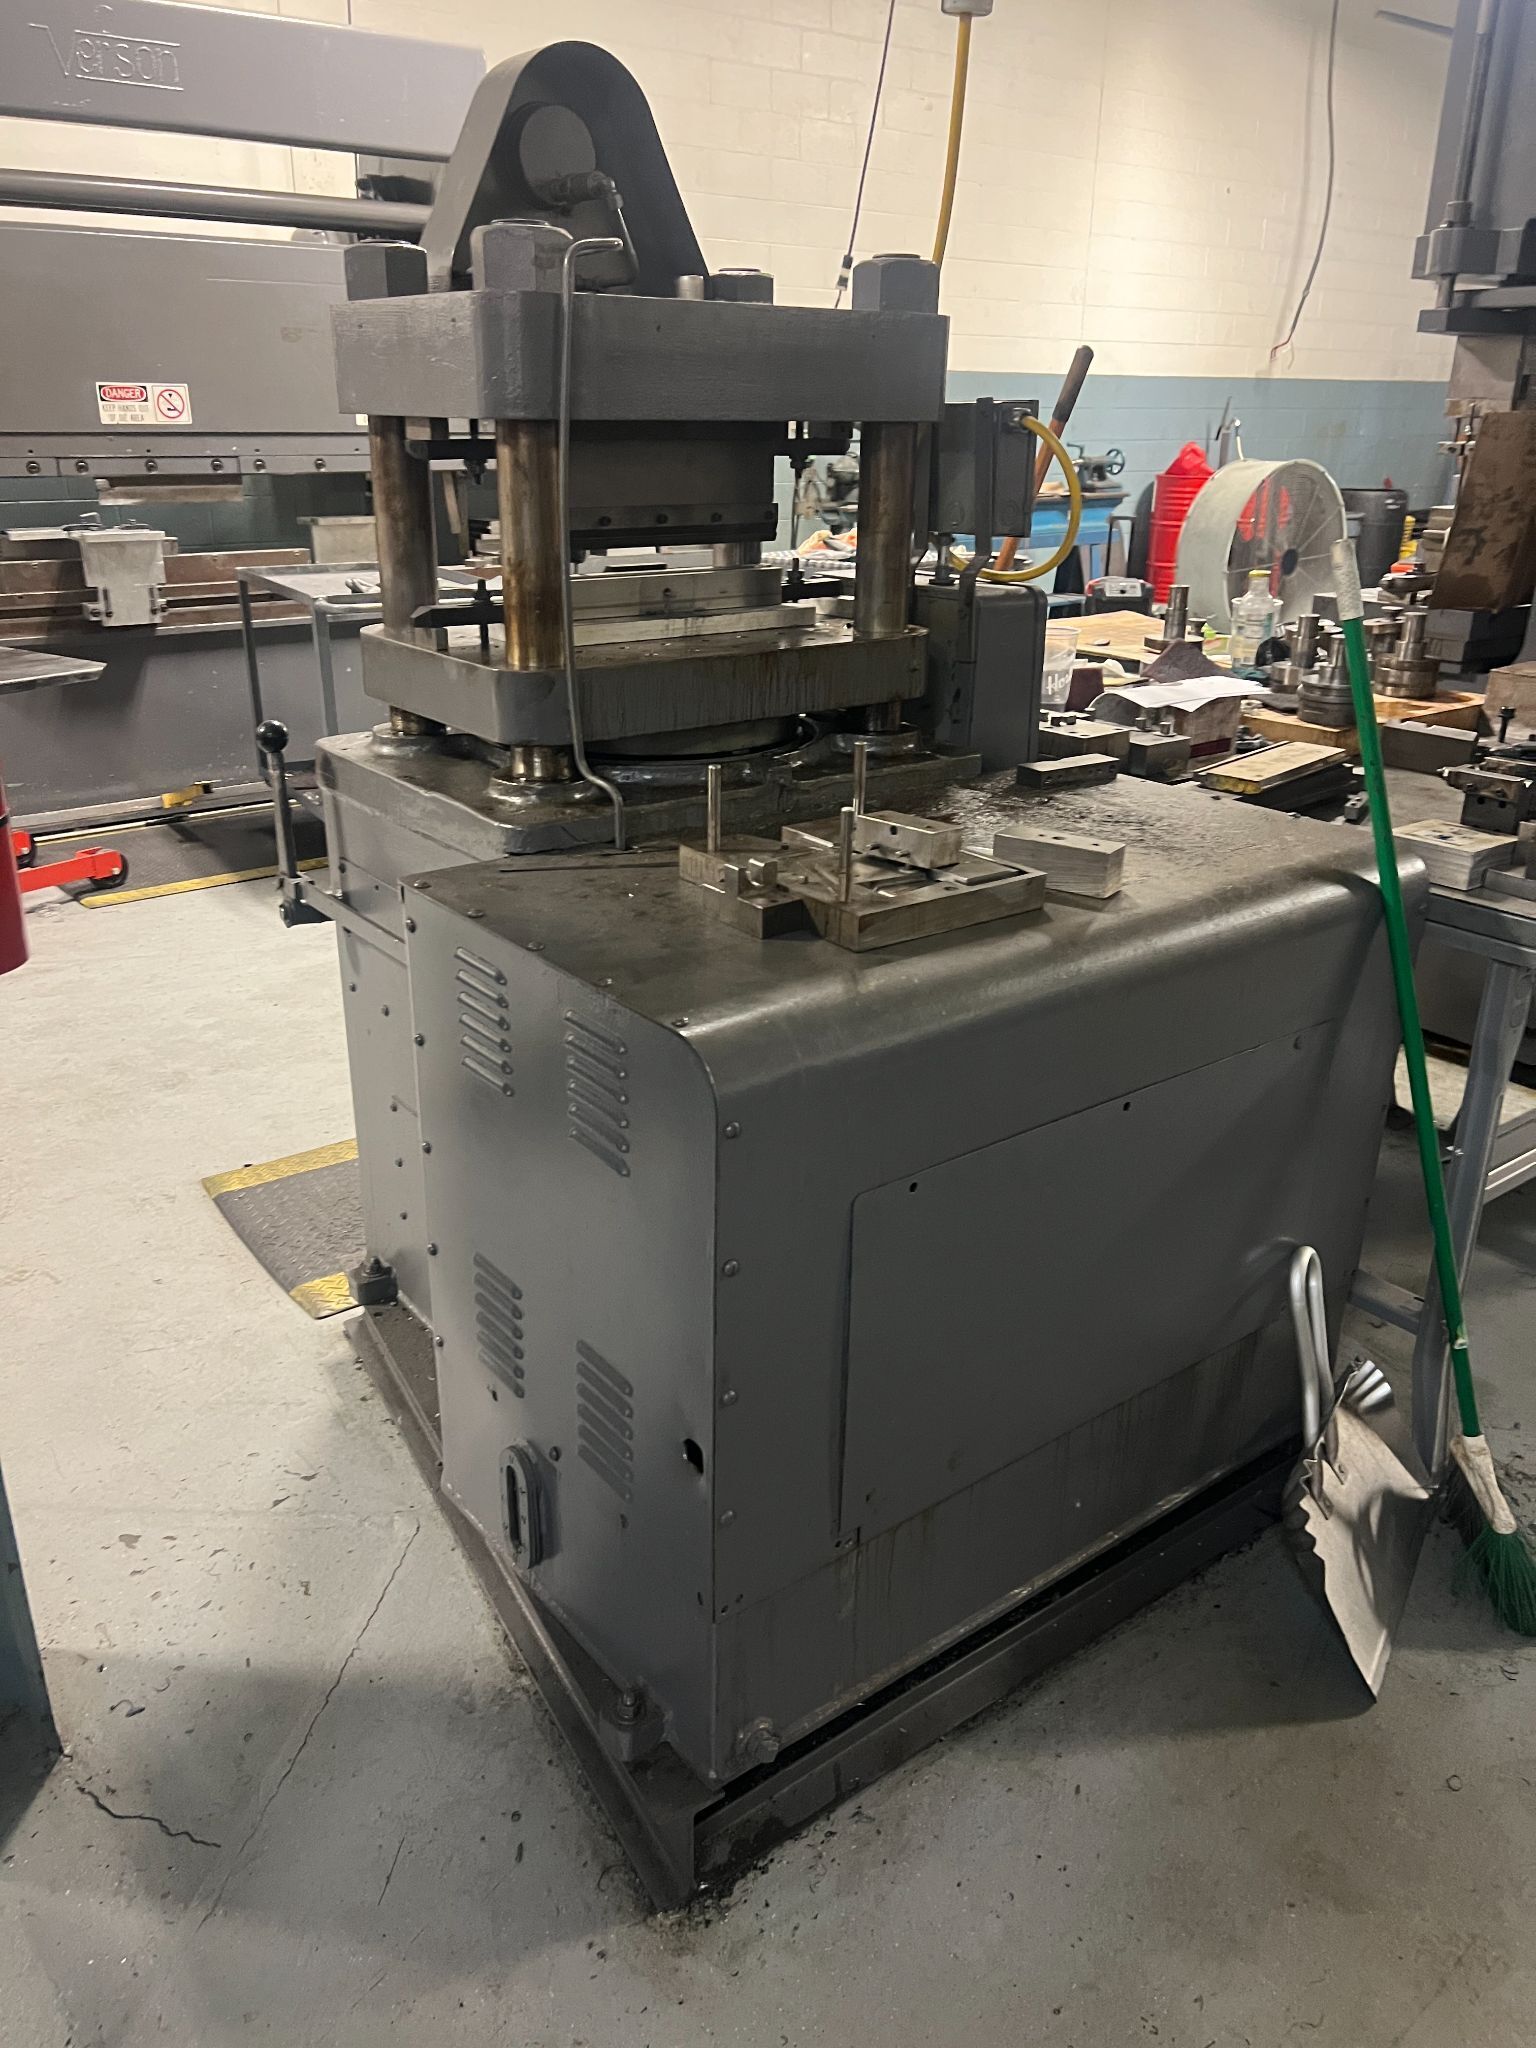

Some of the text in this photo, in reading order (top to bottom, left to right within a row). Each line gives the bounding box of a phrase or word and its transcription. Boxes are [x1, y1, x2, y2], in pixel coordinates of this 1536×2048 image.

[27, 22, 181, 83] Verson
[105, 387, 142, 399] DANGER
[102, 404, 116, 412] KEEP
